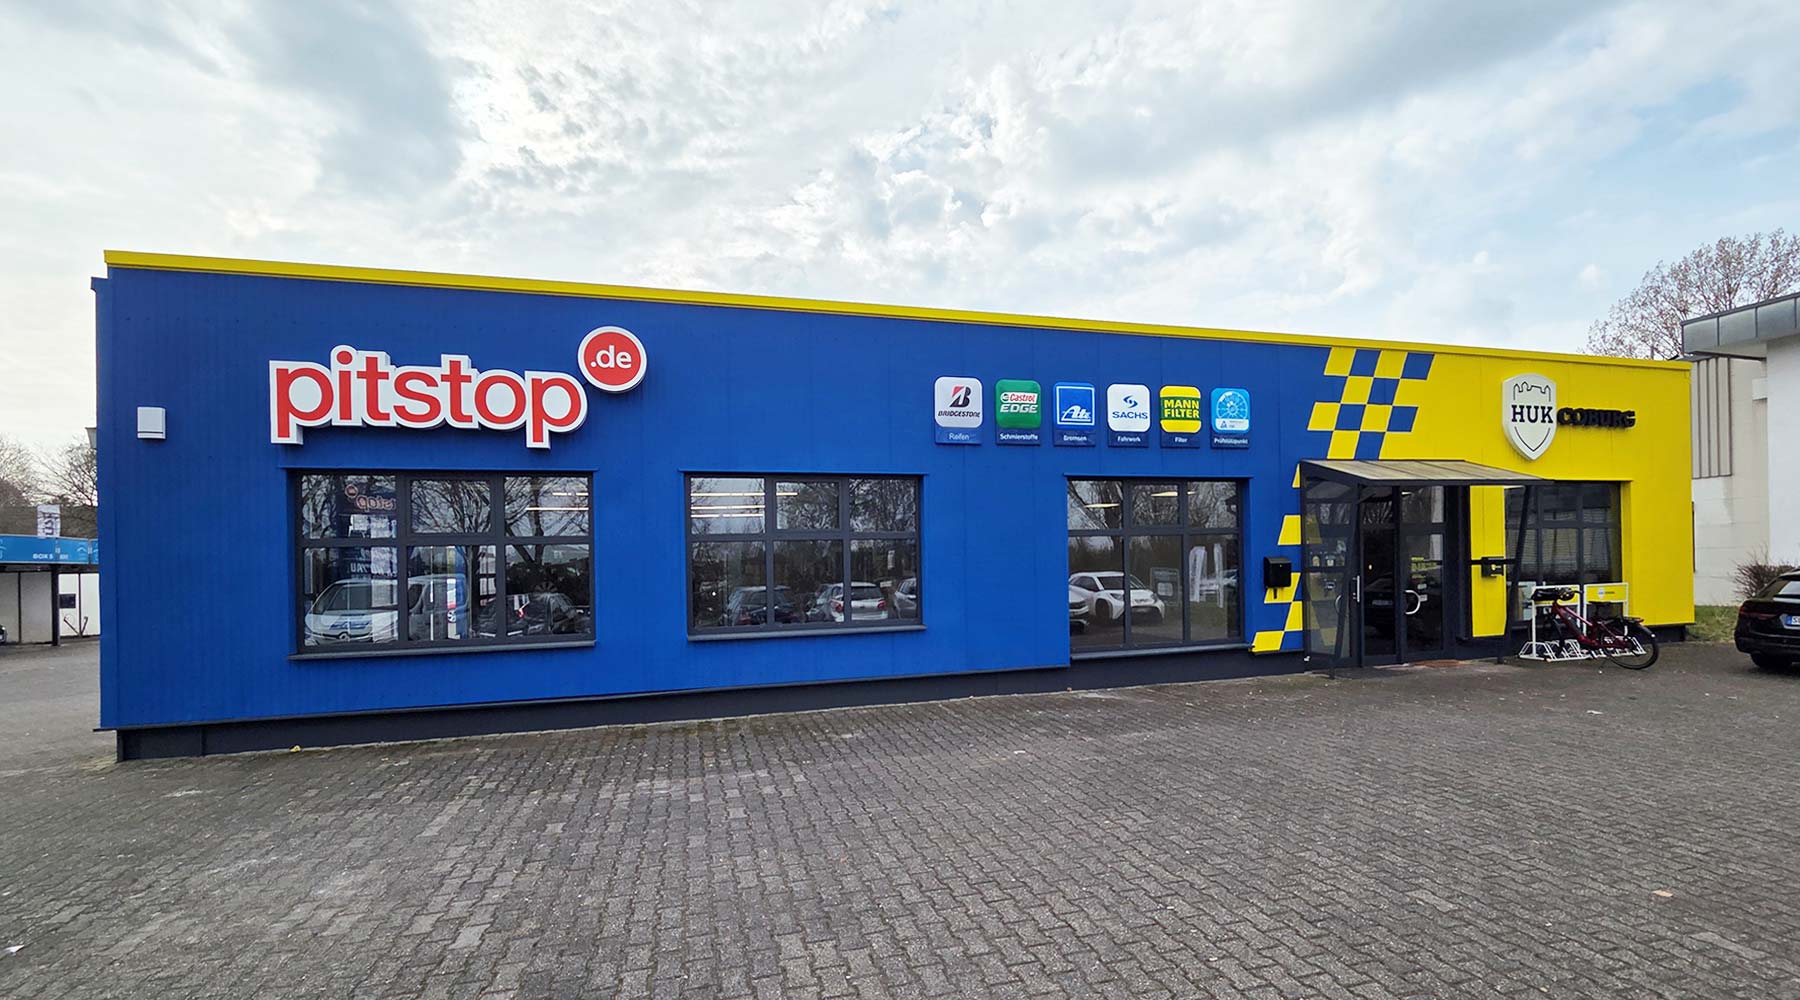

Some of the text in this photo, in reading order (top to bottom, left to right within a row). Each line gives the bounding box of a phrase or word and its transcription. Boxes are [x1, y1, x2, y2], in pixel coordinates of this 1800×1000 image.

[590, 345, 632, 369] .de
[272, 348, 586, 447] pitstop
[1009, 393, 1036, 402] Castrol
[1000, 404, 1039, 413] EDGE
[1164, 399, 1199, 409] MANN
[937, 410, 981, 418] BRIDGESTONE
[1112, 411, 1149, 419] SACHS
[1164, 408, 1199, 418] FILTER
[1511, 404, 1636, 428] HUK COBURG
[948, 432, 970, 441] Reifen
